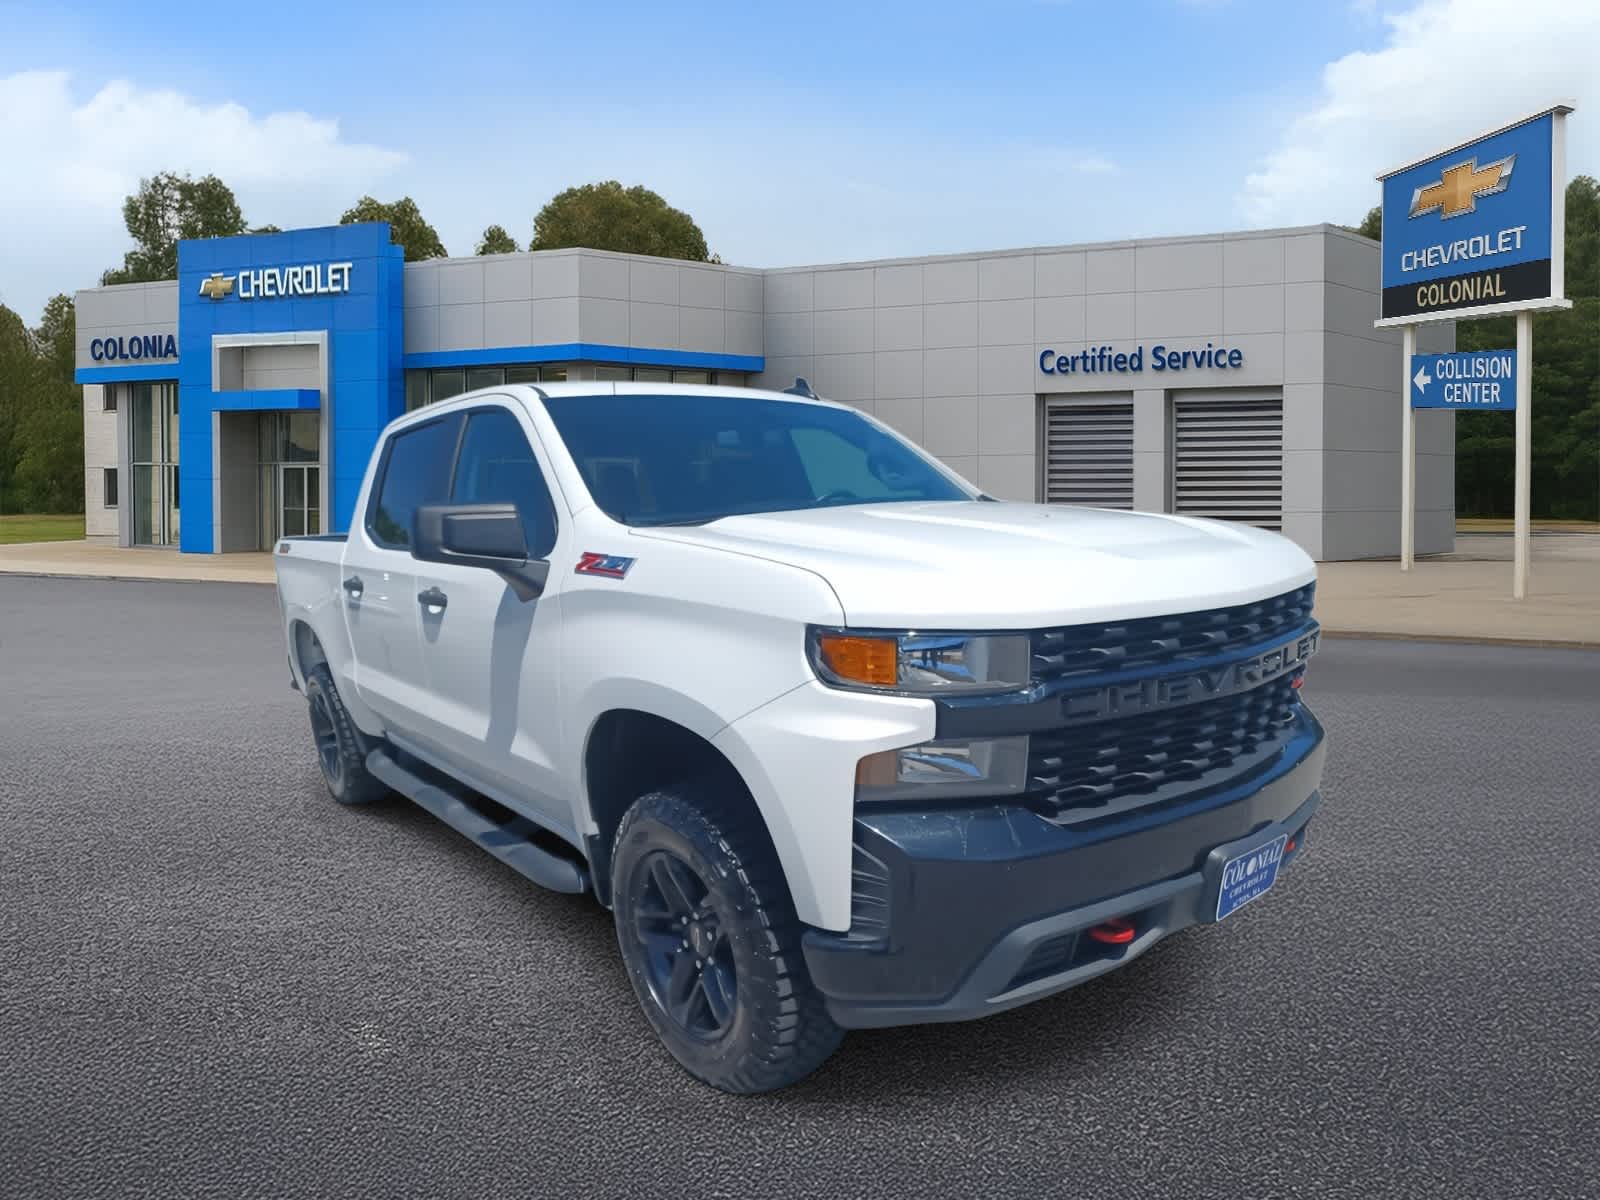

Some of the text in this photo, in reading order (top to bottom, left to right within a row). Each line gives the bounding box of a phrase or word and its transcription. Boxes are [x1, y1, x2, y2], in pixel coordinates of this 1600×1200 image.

[1401, 225, 1528, 272] CHEVROLET
[238, 262, 353, 298] CHEVROLET
[1416, 273, 1506, 308] COLONIAL
[91, 334, 178, 361] COLONIA
[1039, 343, 1243, 375] Certified Service
[1436, 356, 1512, 379] COLLISION
[1444, 382, 1501, 403] CENTER
[1059, 631, 1320, 719] CHEVROLET
